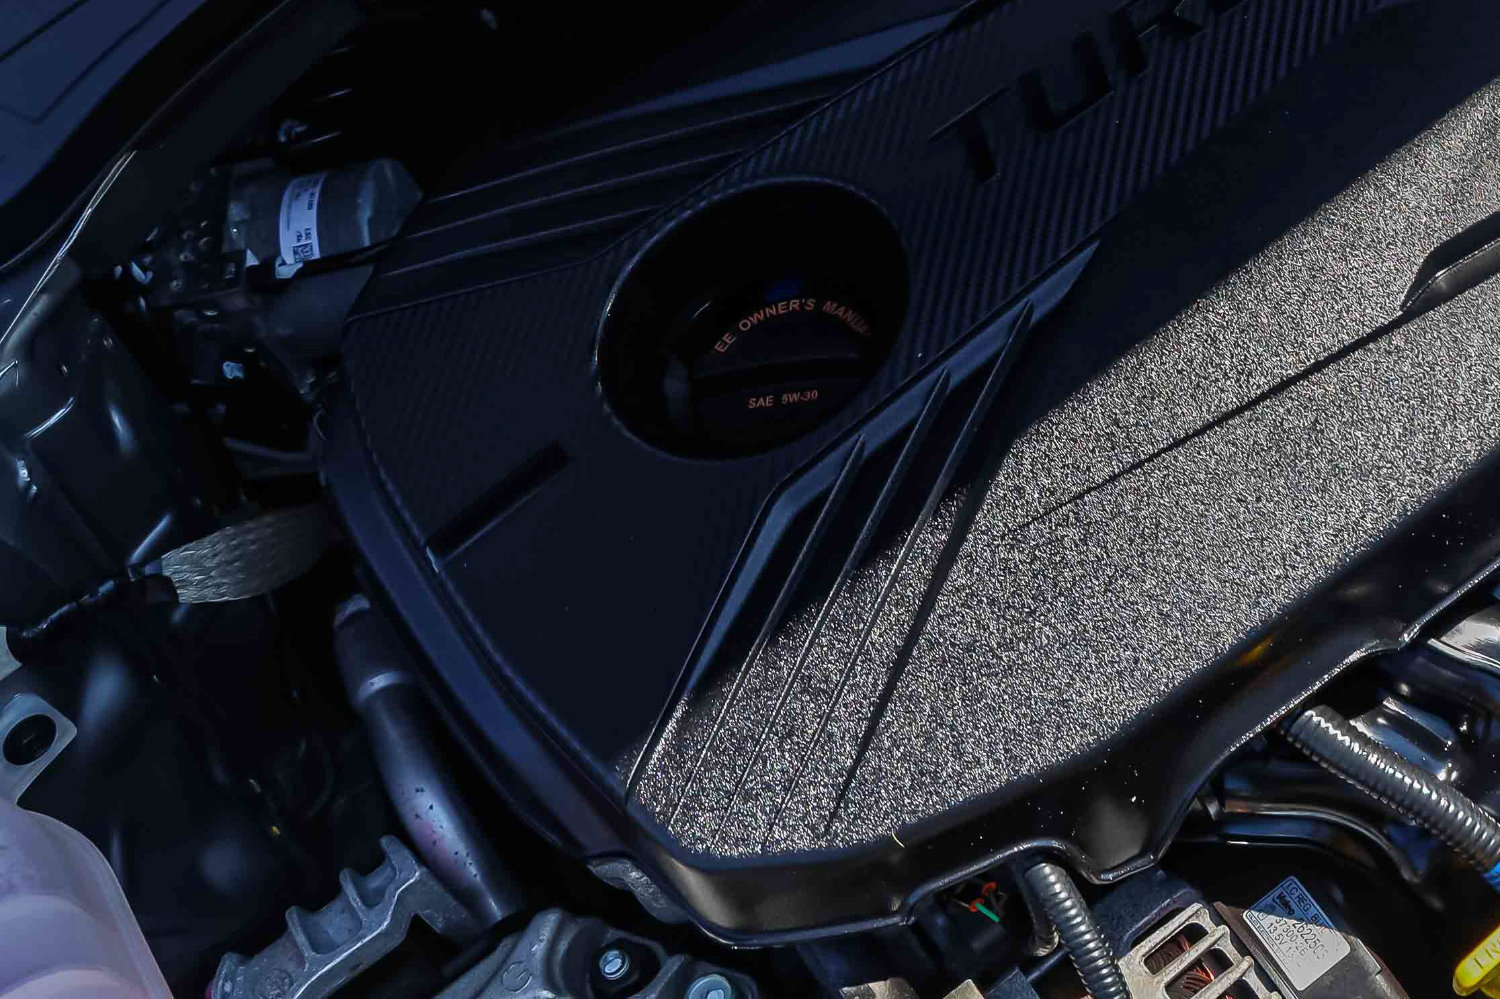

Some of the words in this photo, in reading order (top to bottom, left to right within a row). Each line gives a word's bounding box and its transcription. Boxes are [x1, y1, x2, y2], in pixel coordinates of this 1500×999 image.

[713, 331, 737, 354] EE
[737, 298, 817, 332] OWNER'S
[747, 395, 775, 409] SAE
[781, 389, 819, 405] 5W-30
[1296, 894, 1312, 912] REG
[1266, 922, 1288, 946] 13.5V
